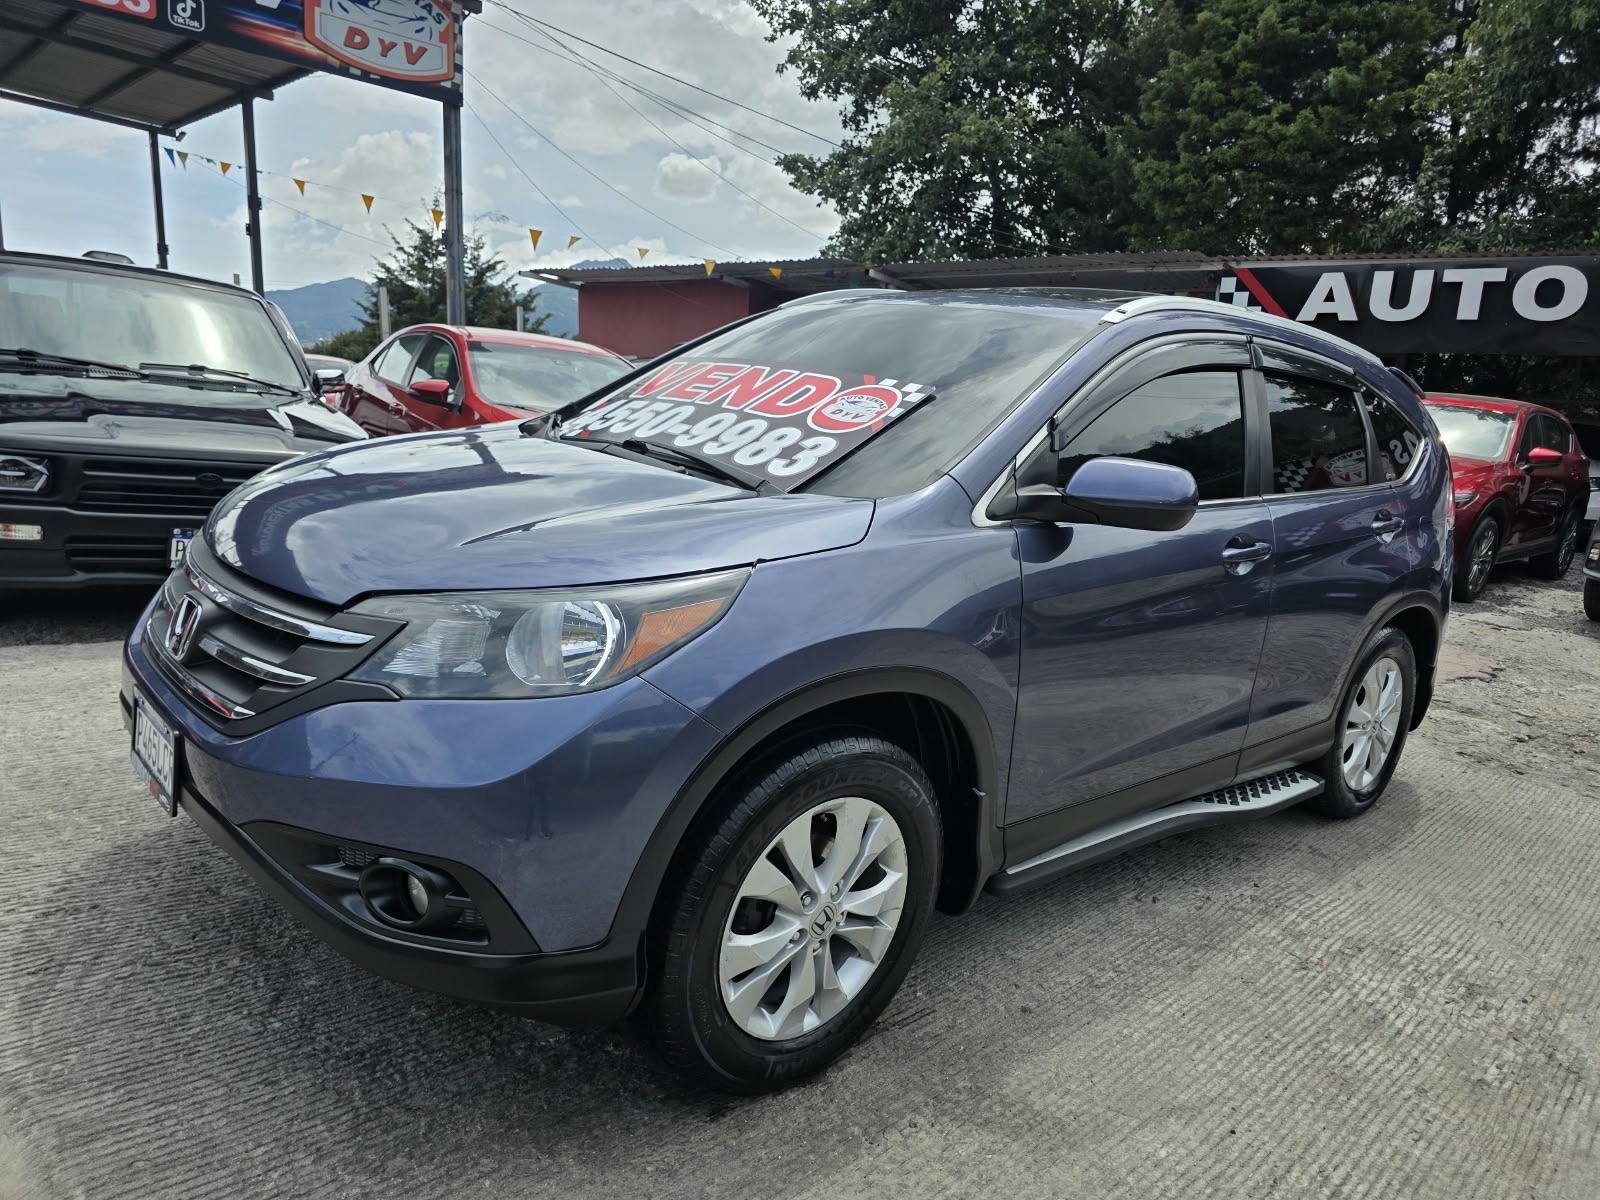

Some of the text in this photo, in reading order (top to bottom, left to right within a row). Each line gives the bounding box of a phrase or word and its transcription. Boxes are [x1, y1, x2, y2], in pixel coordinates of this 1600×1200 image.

[172, 14, 201, 28] TikTok
[414, 0, 445, 25] AS
[343, 26, 428, 66] DYV
[1295, 264, 1589, 322] AUTO
[830, 408, 867, 420] DYV
